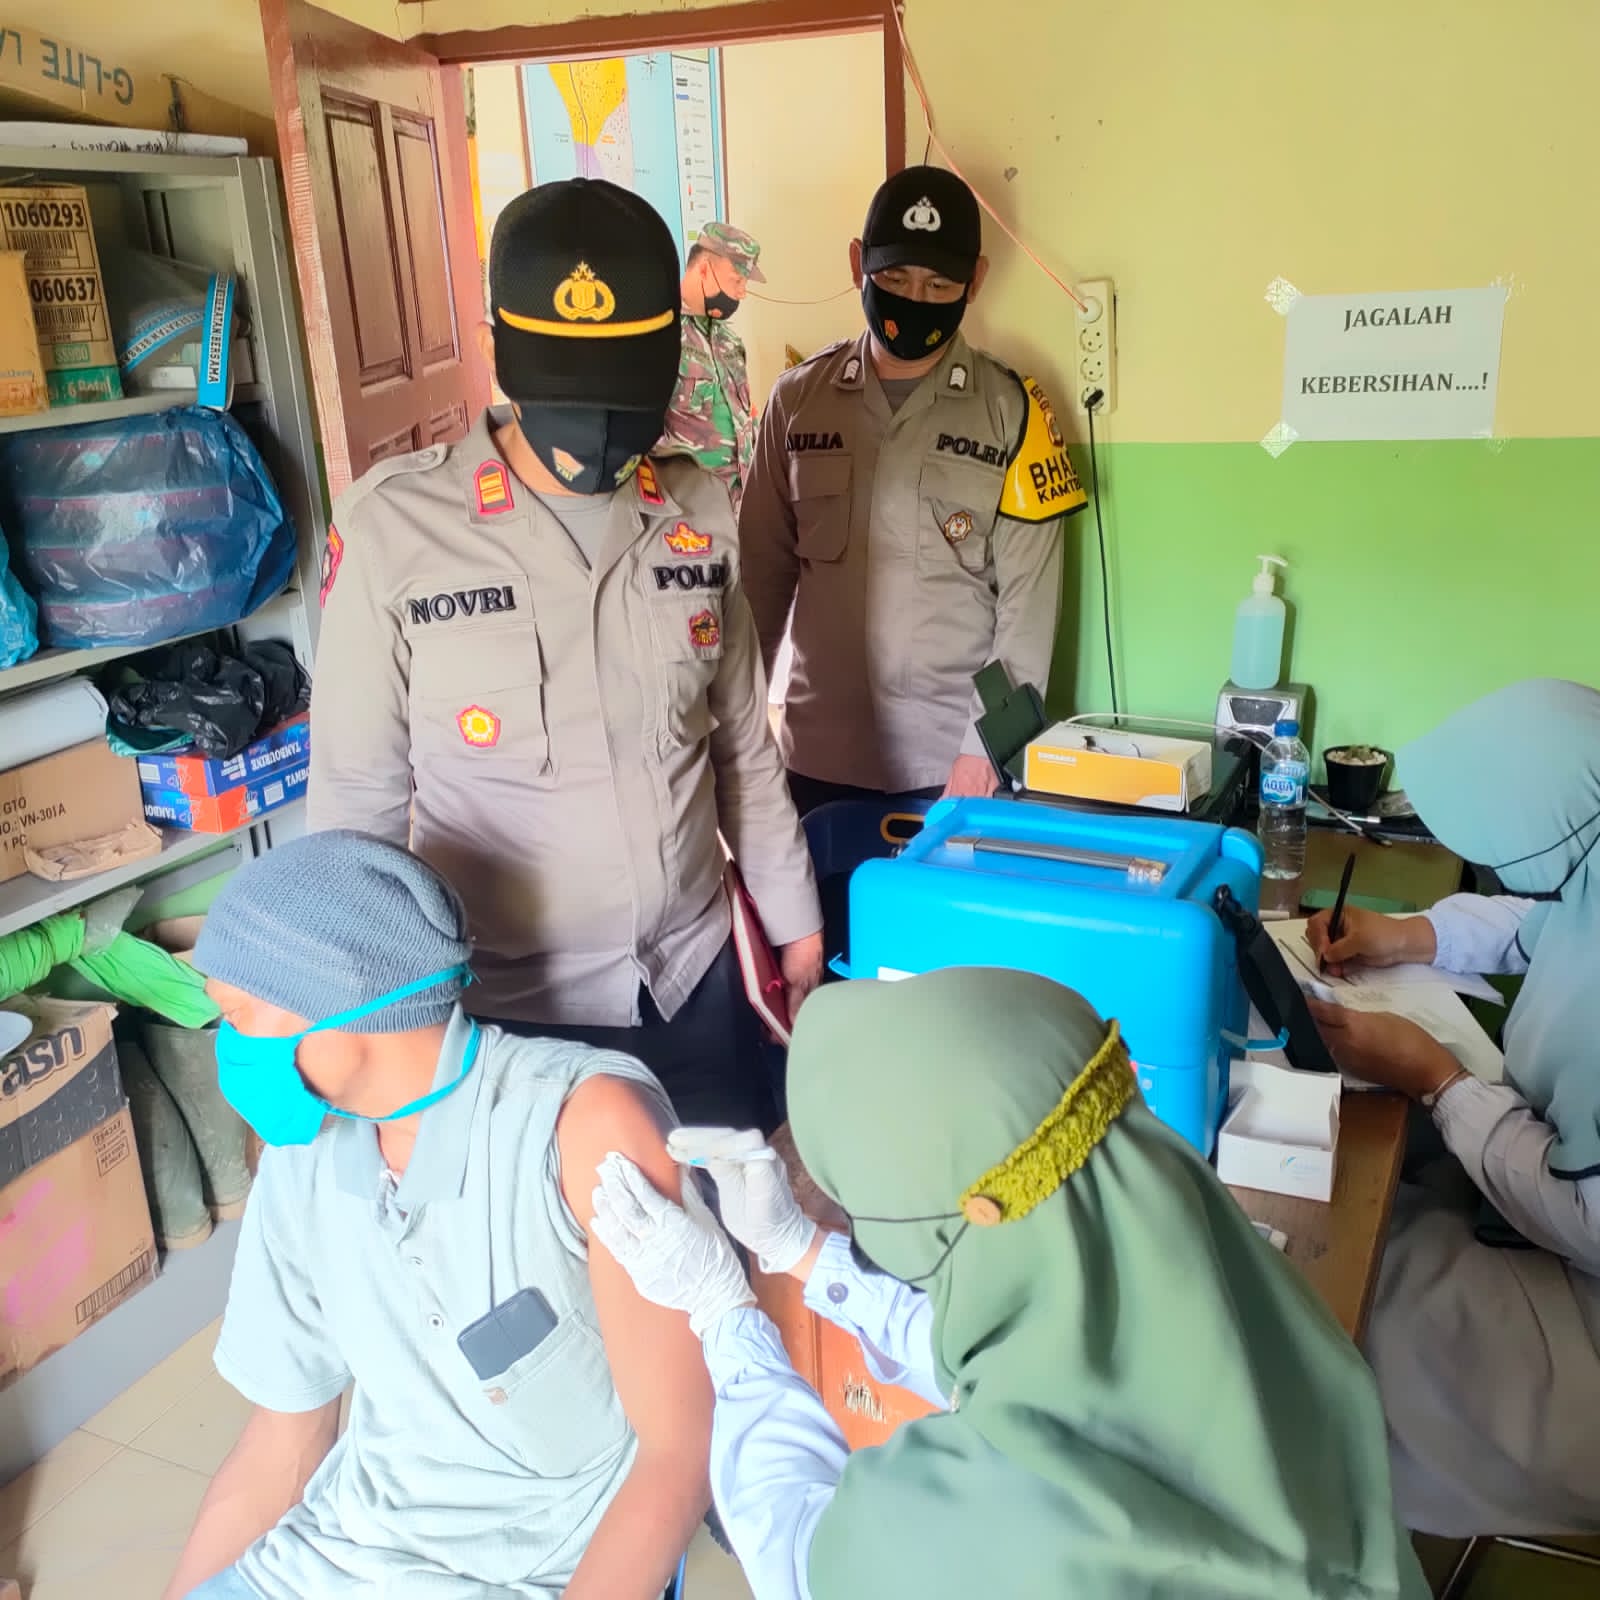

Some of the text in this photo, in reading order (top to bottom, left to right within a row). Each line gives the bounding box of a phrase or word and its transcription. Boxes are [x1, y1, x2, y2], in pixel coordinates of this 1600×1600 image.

[40, 38, 134, 105] G-LITE
[4, 202, 84, 228] 1060293
[1344, 305, 1452, 332] JAGALAH
[1300, 372, 1489, 395] KEBERSIHAN....!
[936, 433, 1006, 468] POLRI
[408, 585, 516, 625] NOVRI
[250, 741, 301, 772] TAMBOURINE
[1264, 779, 1294, 793] AQUA
[3, 796, 27, 815] GTO
[19, 802, 66, 828] VN-301A
[12, 834, 28, 849] PC
